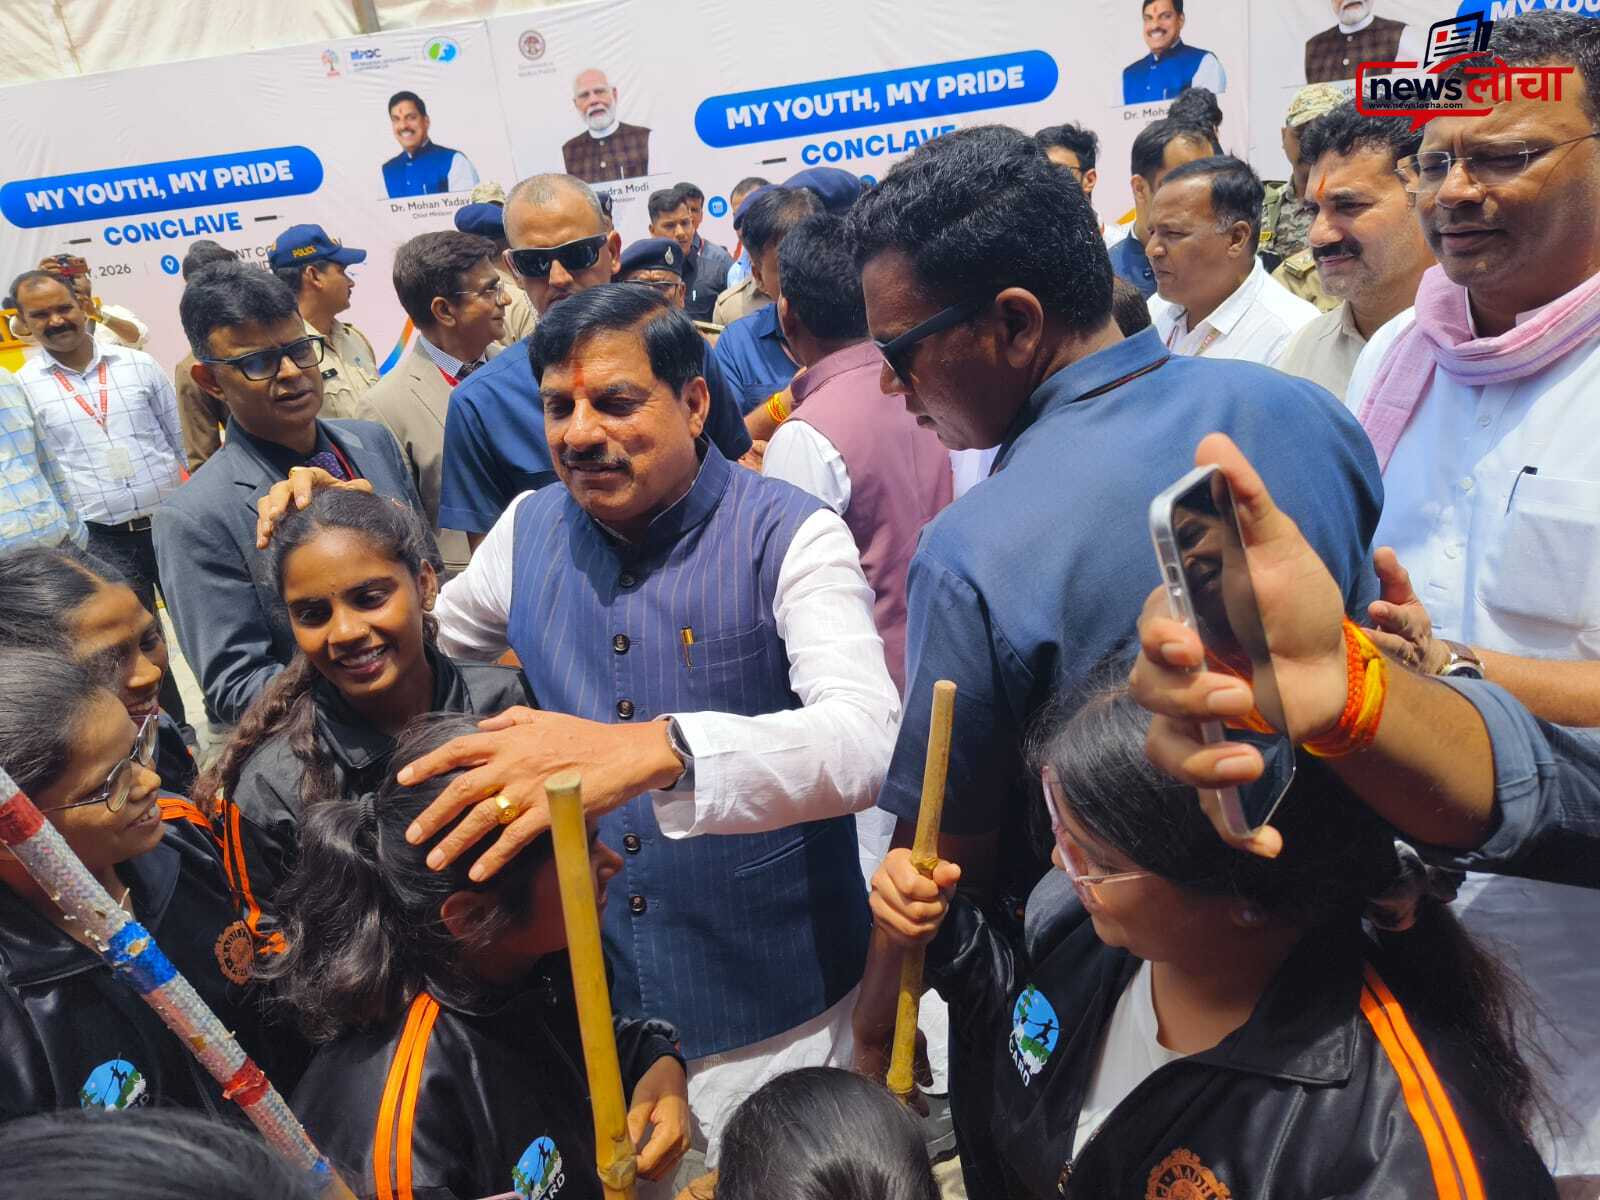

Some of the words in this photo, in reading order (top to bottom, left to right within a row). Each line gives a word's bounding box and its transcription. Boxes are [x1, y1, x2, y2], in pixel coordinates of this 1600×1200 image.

[726, 103, 767, 130] MY
[772, 88, 880, 124] YOUTH,
[886, 79, 931, 107] MY
[937, 65, 1025, 101] PRIDE
[25, 188, 65, 213] MY
[68, 176, 167, 206] YOUTH,
[170, 171, 207, 195] MY
[213, 160, 294, 189] PRIDE
[625, 182, 649, 193] Modi
[391, 204, 406, 213] Dr.
[408, 200, 440, 211] Mohan
[103, 211, 243, 246] CONCLAVE
[291, 245, 317, 258] POLICE
[100, 264, 132, 278] 2026
